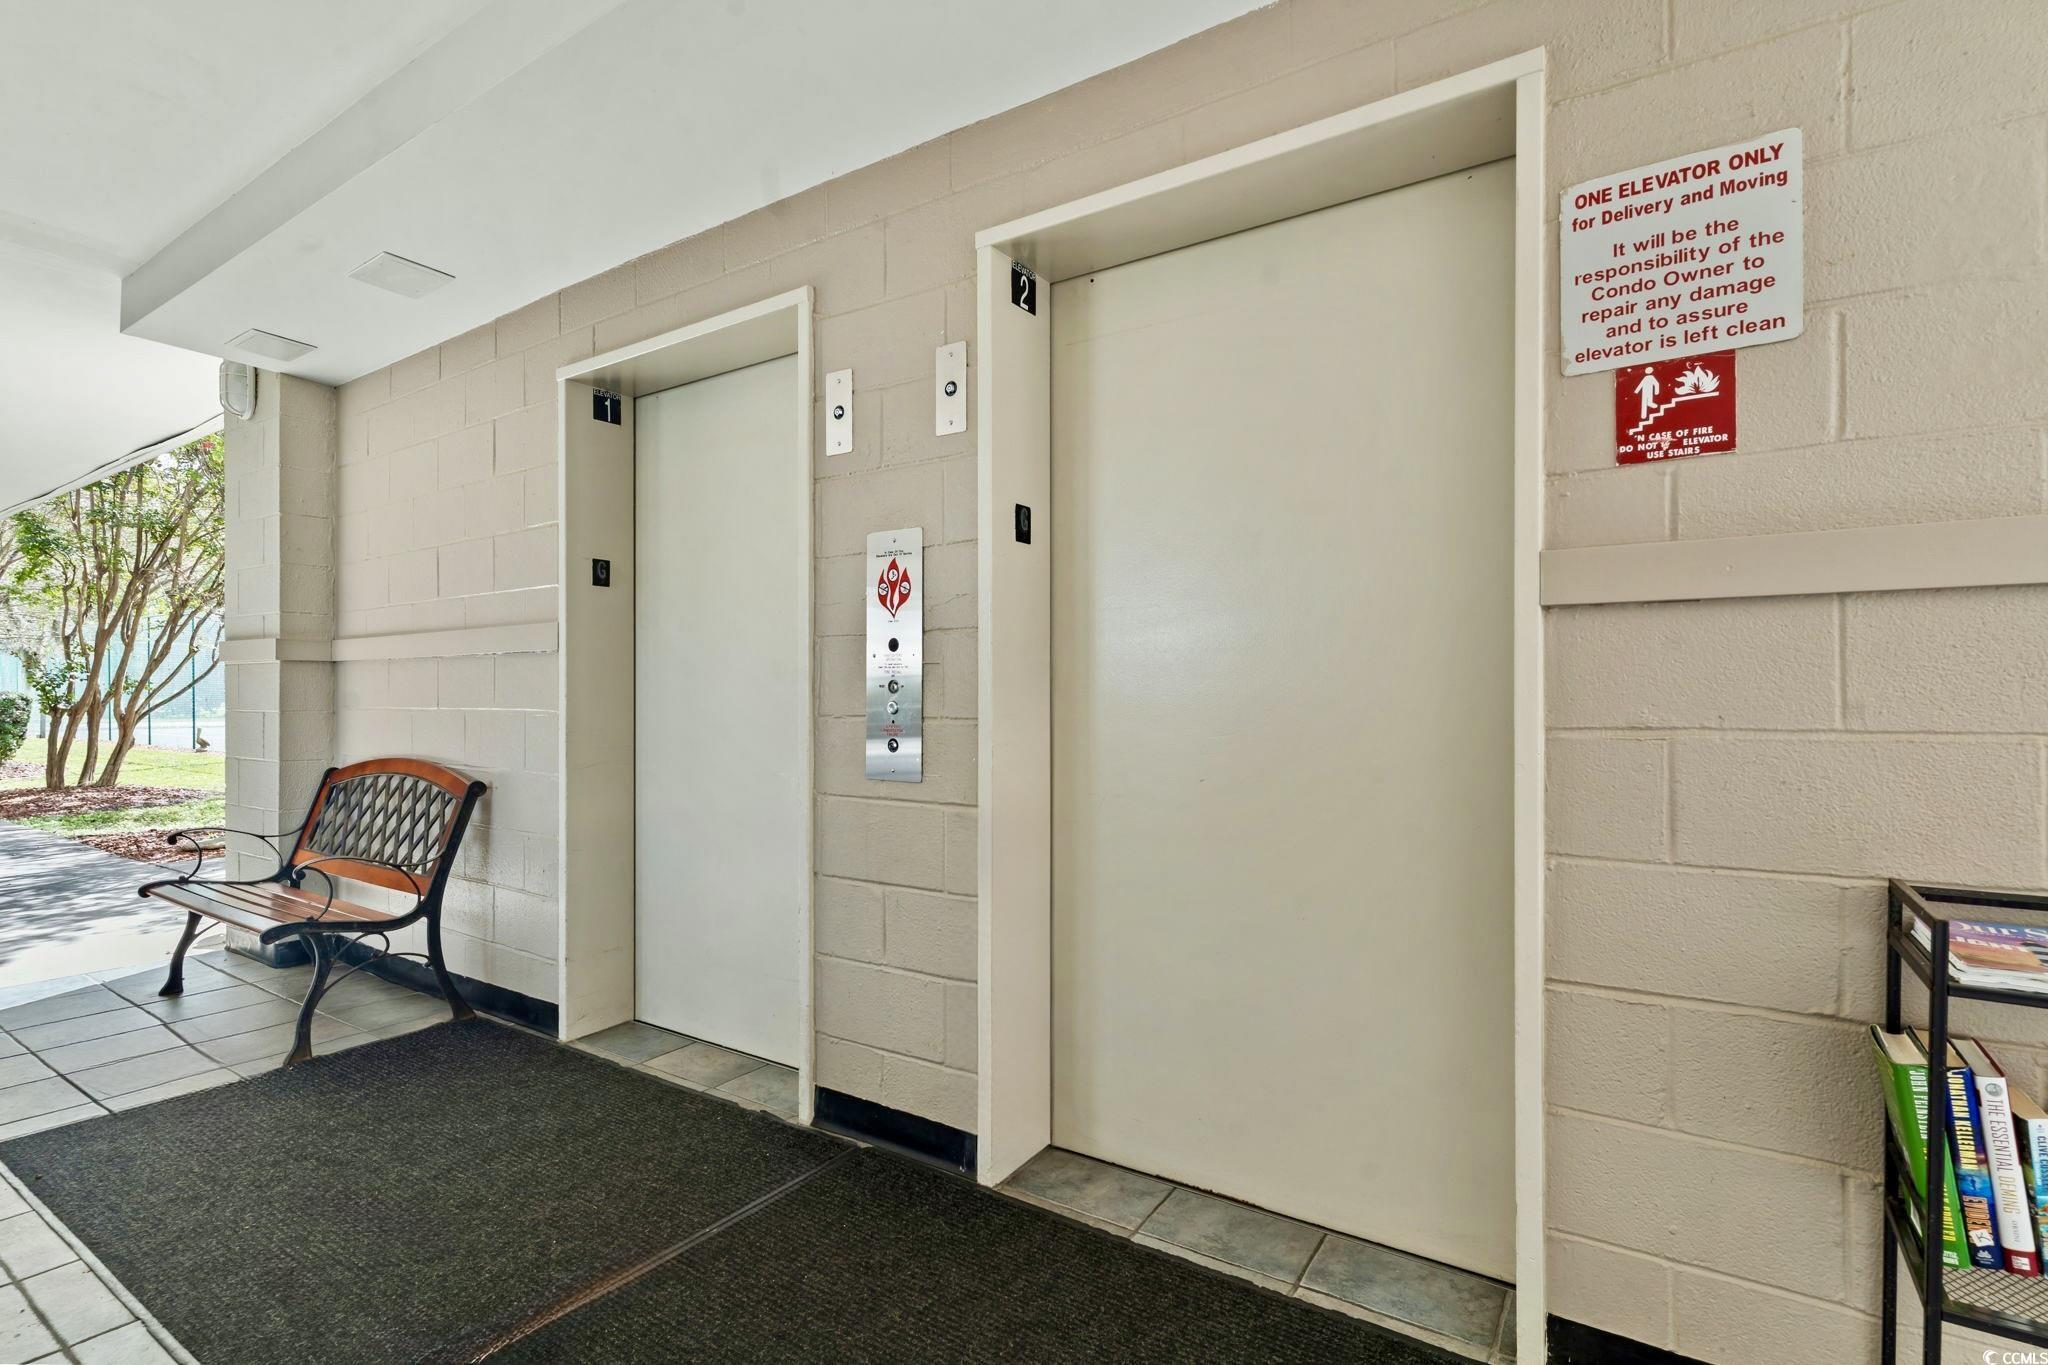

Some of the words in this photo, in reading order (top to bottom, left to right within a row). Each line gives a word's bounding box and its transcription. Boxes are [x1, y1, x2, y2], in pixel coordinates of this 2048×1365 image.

[1574, 187, 1613, 210] ONE
[1618, 160, 1721, 199] ELEVATOR
[1728, 143, 1784, 171] ONLY
[1571, 216, 1596, 233] for
[1602, 197, 1674, 226] Delivery
[1680, 185, 1714, 206] and
[1720, 170, 1788, 196] Moving
[1574, 246, 1710, 286] responsibility
[1719, 236, 1741, 254] of
[1749, 230, 1785, 248] the
[1613, 243, 1626, 257] It
[1633, 233, 1665, 253] will
[1672, 228, 1697, 244] be
[1705, 219, 1739, 237] the
[1020, 274, 1029, 310] 2
[1591, 277, 1656, 301] Condo
[1663, 261, 1734, 286] Owner
[1743, 255, 1765, 270] to
[1581, 301, 1638, 323] repair
[1646, 293, 1682, 310] any
[1690, 275, 1776, 301] damage
[1575, 339, 1652, 363] elevator
[1660, 334, 1677, 348] is
[1684, 324, 1719, 345] left
[1726, 314, 1786, 337] clean
[1605, 318, 1641, 338] and
[1649, 315, 1669, 330] to
[1676, 301, 1748, 325] assure
[594, 389, 621, 400] ELEVATOR
[604, 398, 611, 422] 1
[1619, 445, 1633, 453] DO
[1637, 442, 1658, 451] NOT
[1683, 433, 1728, 446] ELEVATOR
[1634, 434, 1645, 442] N
[1649, 431, 1672, 441] CASE
[1676, 428, 1689, 438] OF
[1693, 426, 1713, 435] FIRE
[1647, 449, 1664, 459] USE
[1668, 446, 1700, 457] STAIRS
[1909, 1070, 1928, 1092] JOHN
[1946, 1071, 1970, 1118] JONATHAN
[1985, 1099, 2006, 1117] THE
[1954, 1120, 1979, 1170] KELLERMAN
[1989, 1120, 2014, 1172] ESSENTIAL
[1997, 1175, 2021, 1215] DEMING
[1962, 1195, 1993, 1243] EVIDEN
